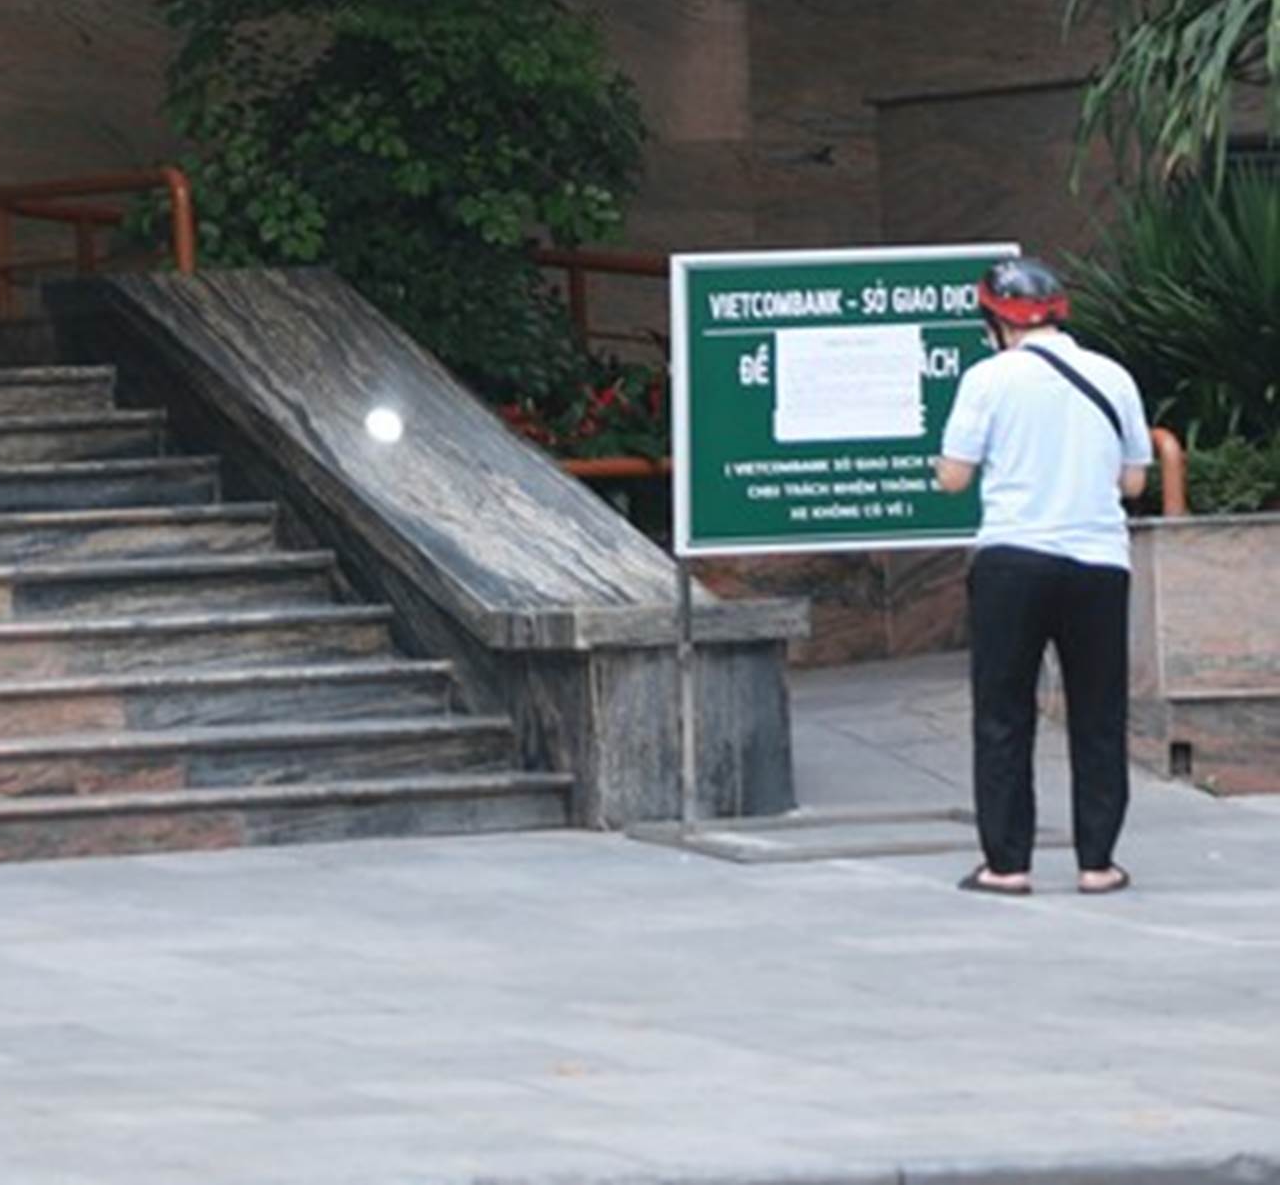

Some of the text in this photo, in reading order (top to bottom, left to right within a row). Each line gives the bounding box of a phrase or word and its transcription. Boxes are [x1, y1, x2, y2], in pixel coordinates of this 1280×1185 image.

[708, 288, 843, 319] VIETCOMBANK
[861, 278, 888, 315] SỞ
[892, 285, 939, 313] GIAO
